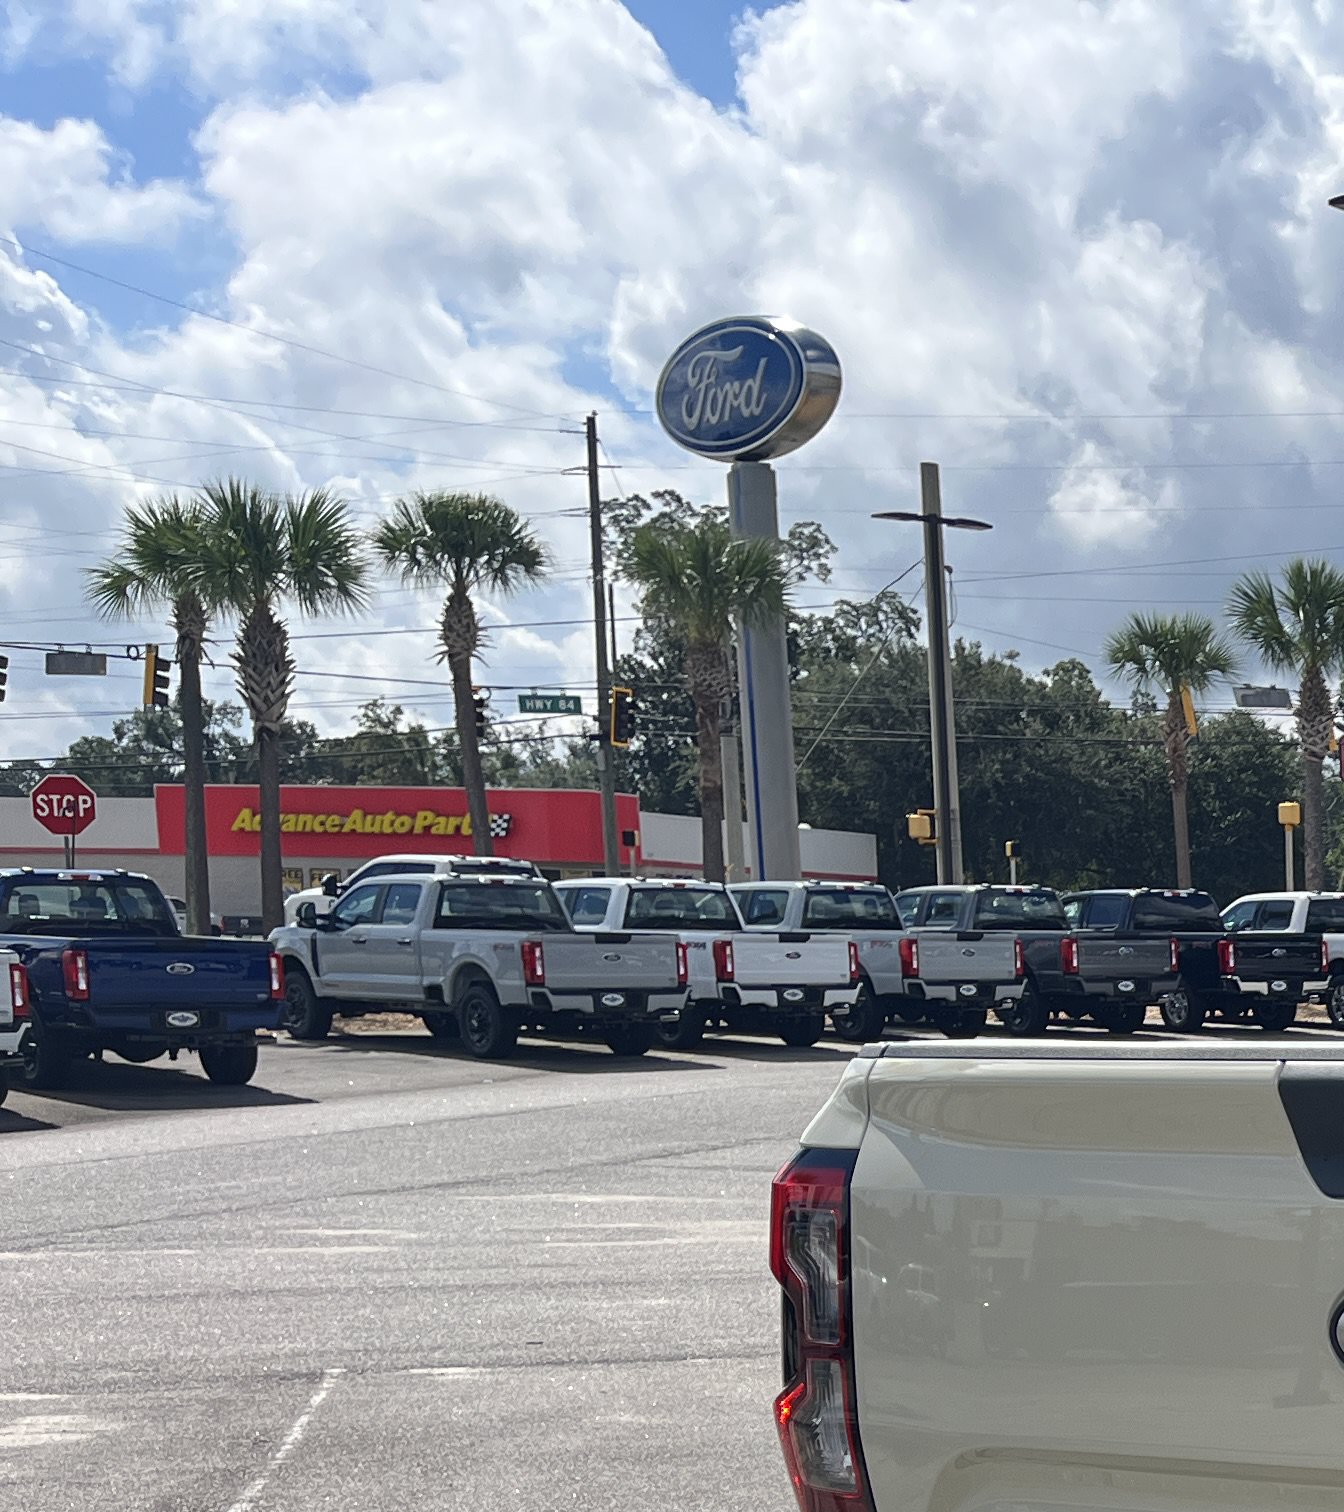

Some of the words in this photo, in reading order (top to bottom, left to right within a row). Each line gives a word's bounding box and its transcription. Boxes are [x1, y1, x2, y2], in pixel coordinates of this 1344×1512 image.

[682, 345, 768, 430] Ford
[525, 699, 552, 710] HWY
[559, 699, 575, 710] 84
[36, 794, 92, 817] STOP
[231, 807, 341, 833] Aance
[342, 808, 412, 834] Auto
[413, 810, 491, 836] Part
